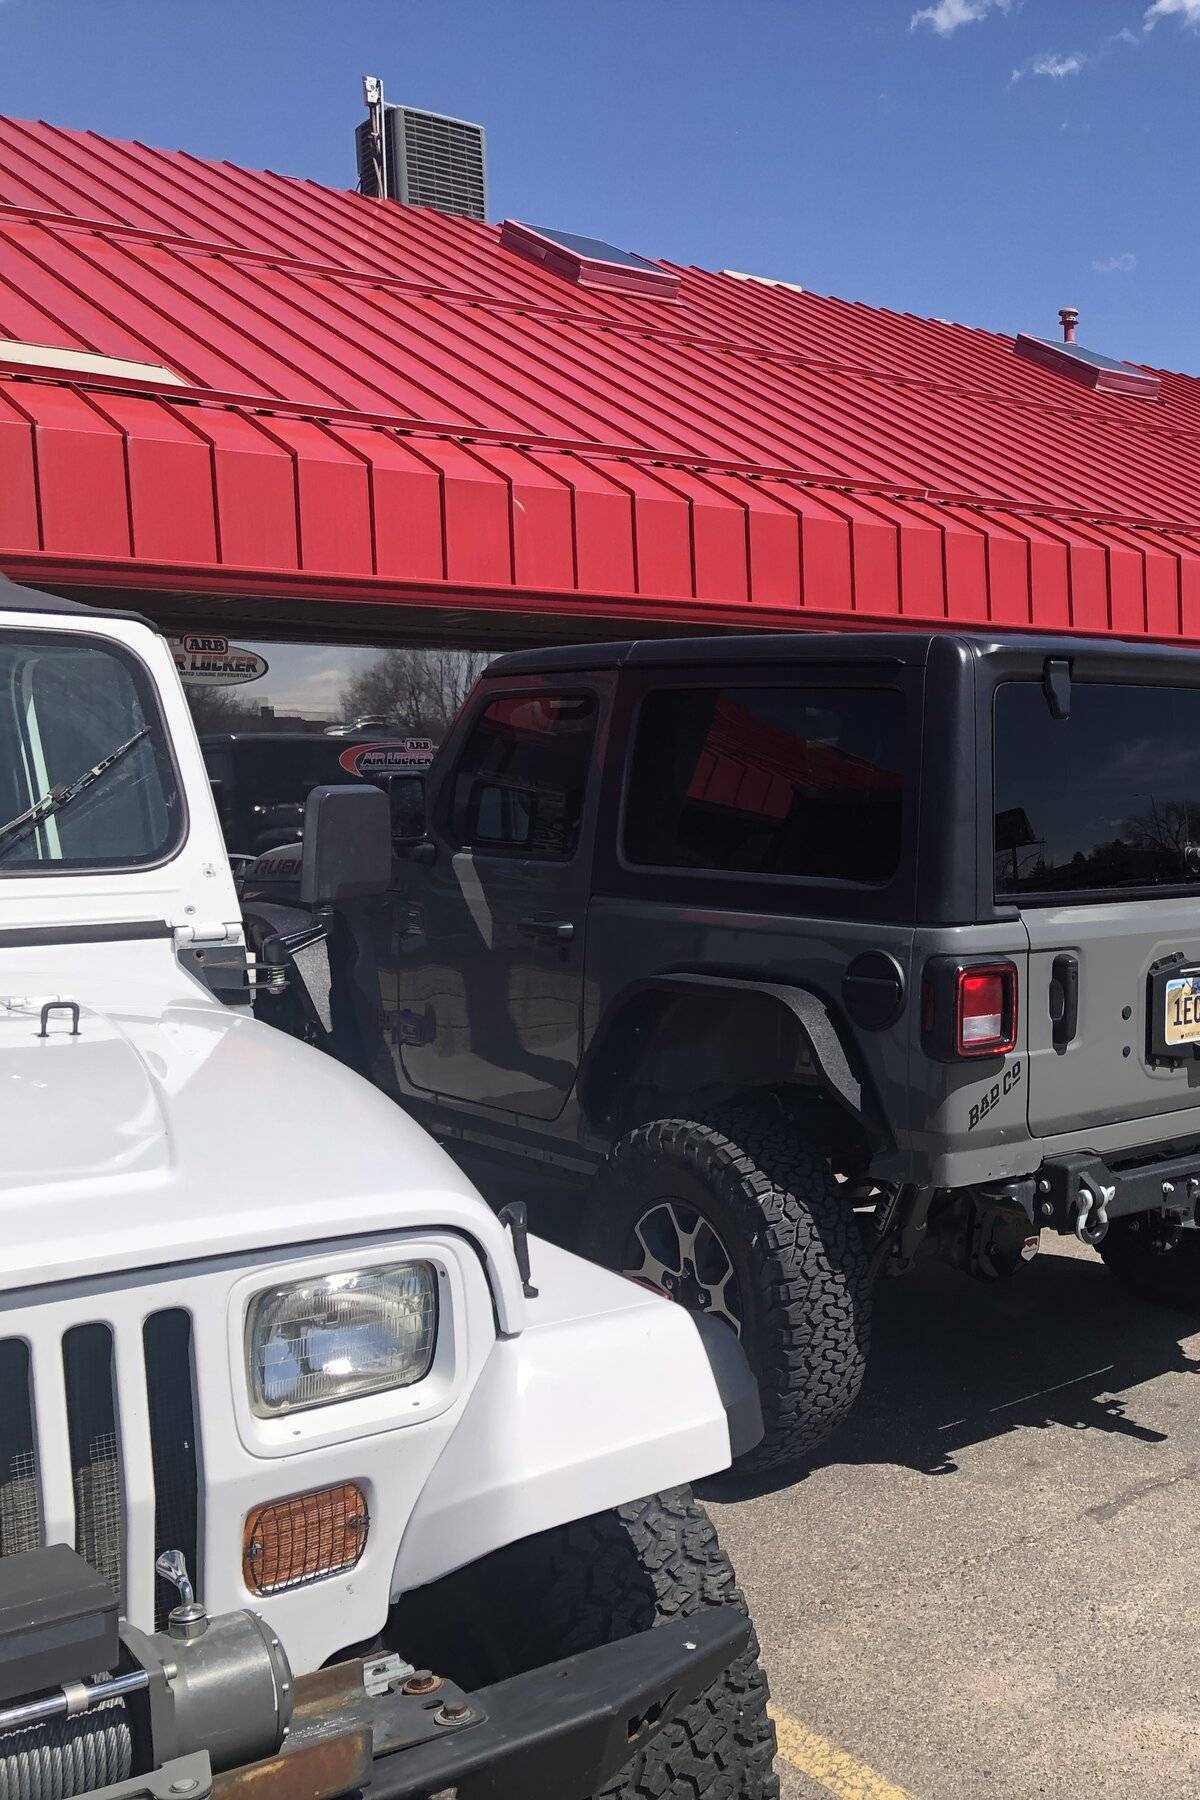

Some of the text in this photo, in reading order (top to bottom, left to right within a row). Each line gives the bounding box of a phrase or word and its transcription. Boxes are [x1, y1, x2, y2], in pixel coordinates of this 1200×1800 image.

[188, 638, 225, 651] ARB
[190, 654, 258, 673] LOCKER
[408, 741, 430, 750] ARB
[362, 752, 386, 765] AIR
[968, 1083, 1000, 1132] BAD
